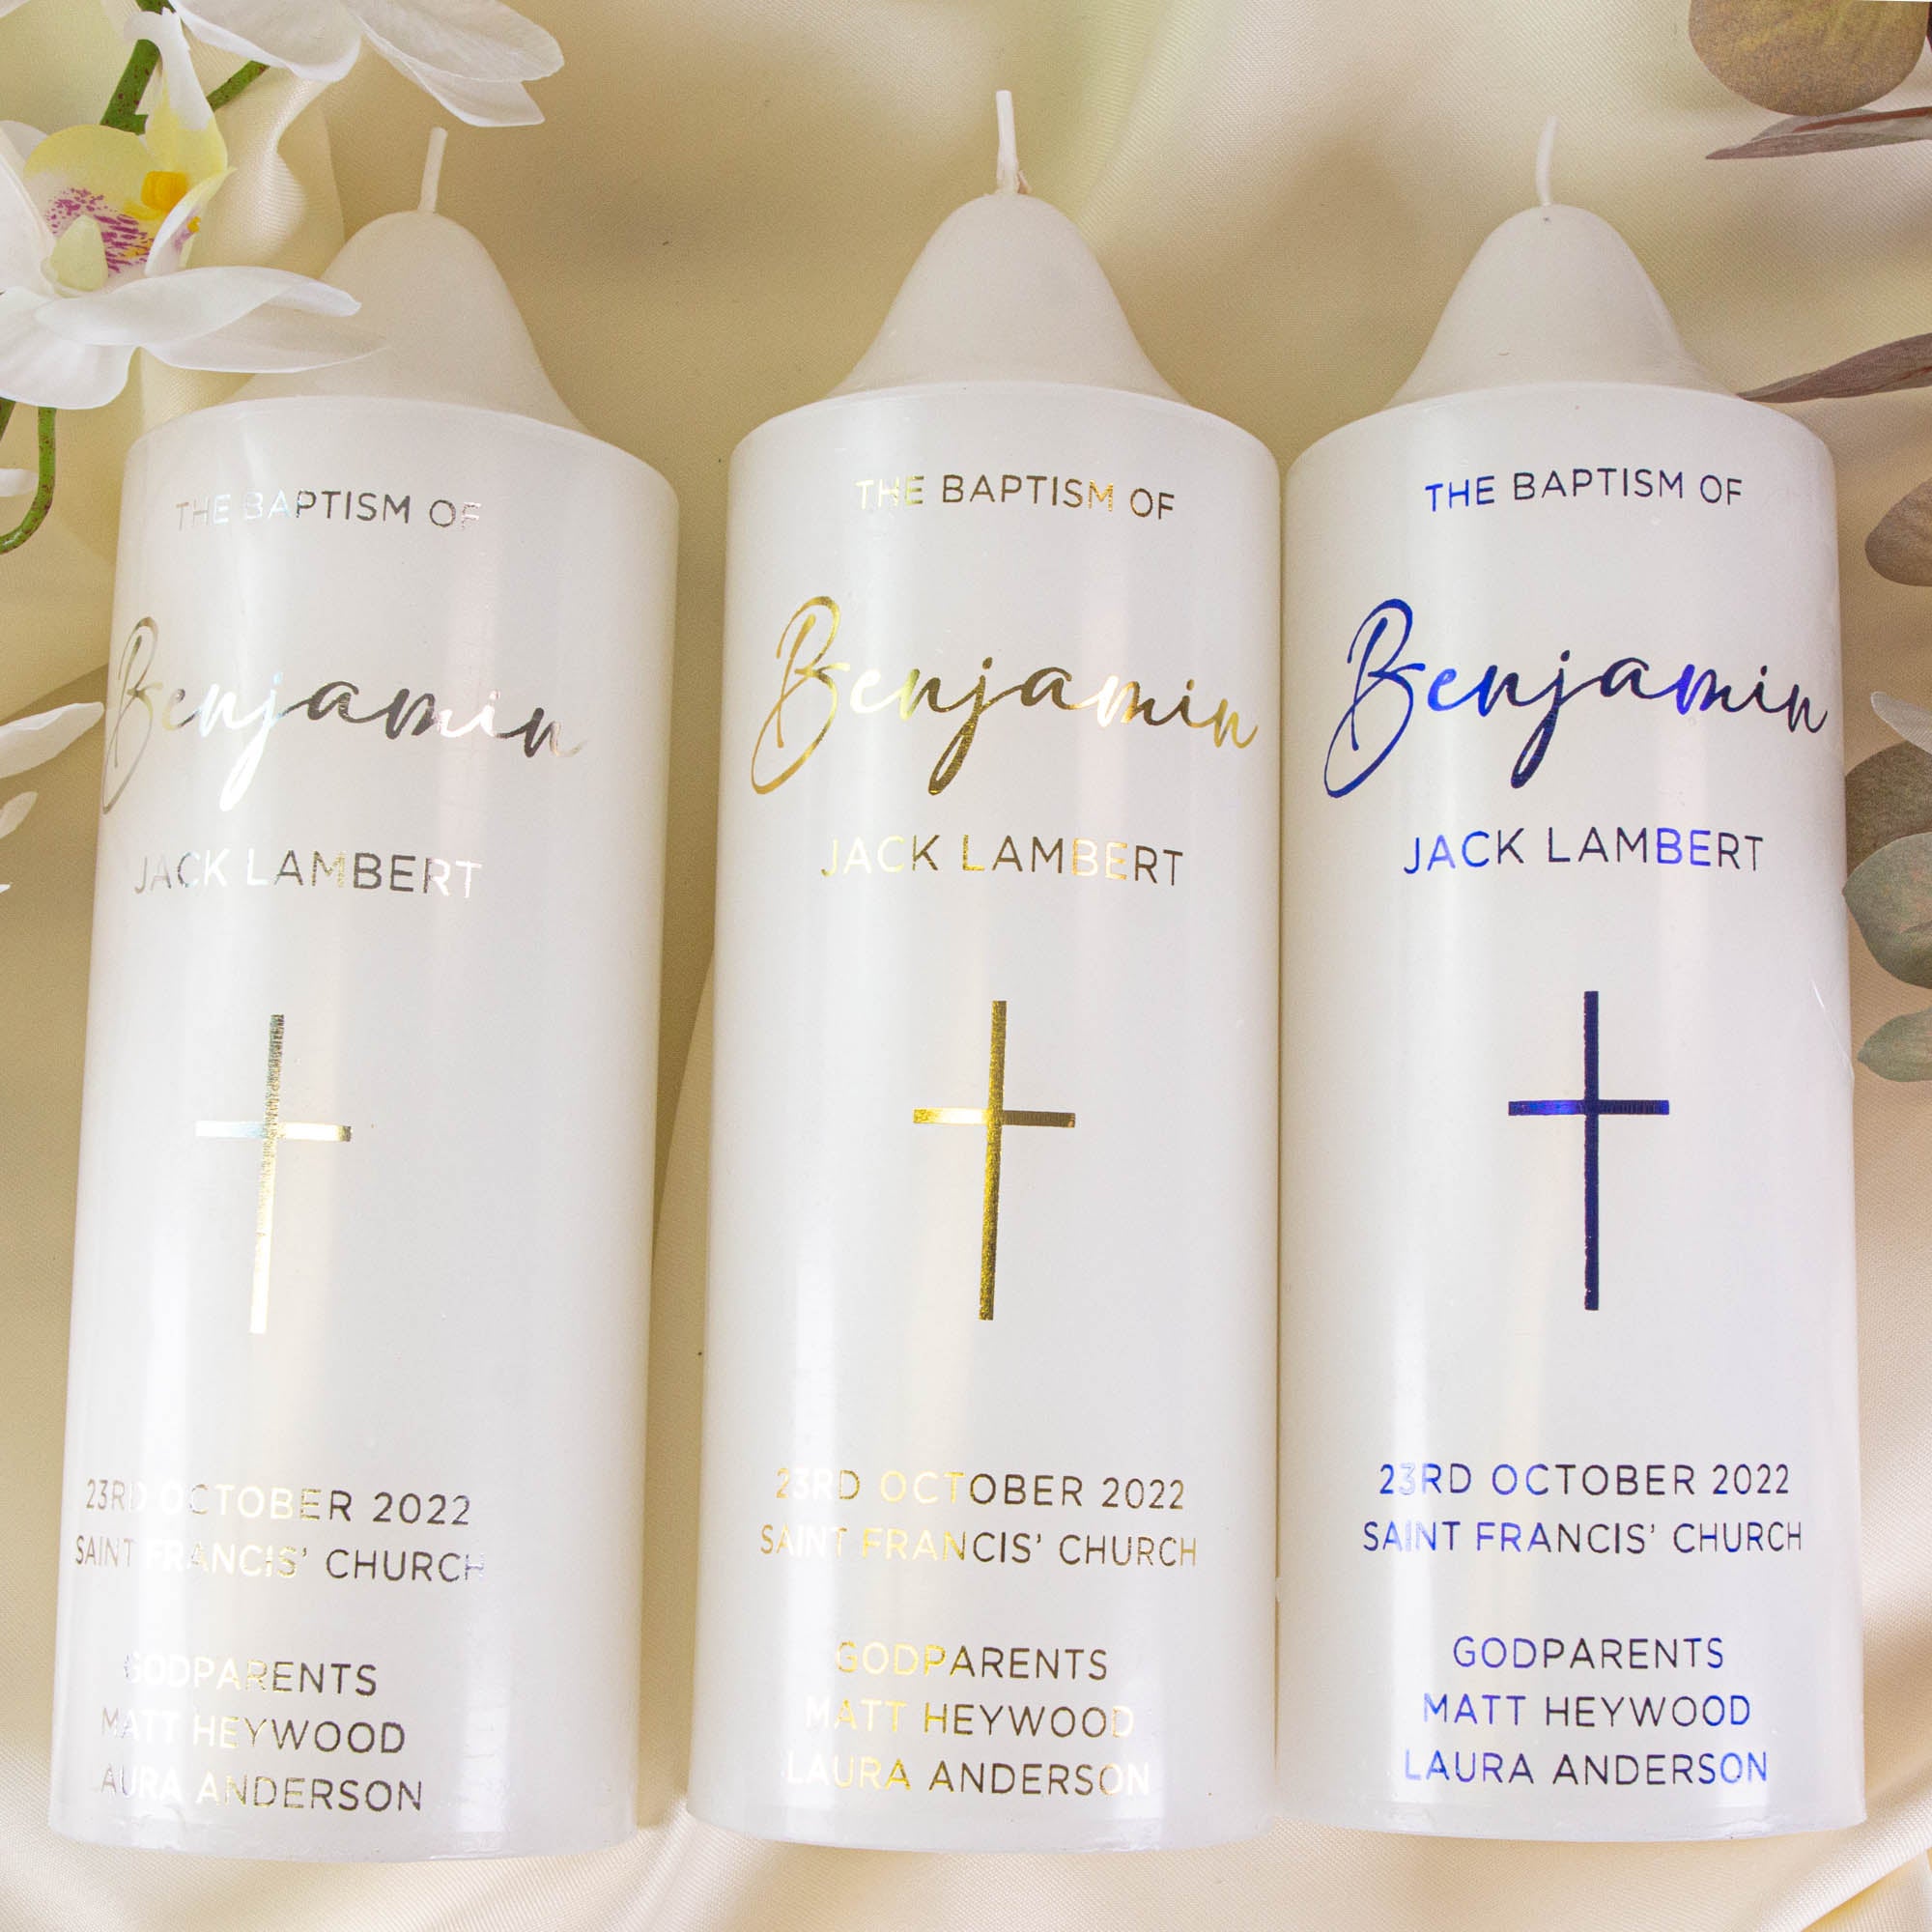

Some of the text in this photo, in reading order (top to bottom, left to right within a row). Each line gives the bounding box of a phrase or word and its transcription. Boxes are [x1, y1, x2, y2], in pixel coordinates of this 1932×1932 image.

[244, 490, 411, 524] BAPTISM
[428, 499, 482, 530] OF
[856, 474, 1175, 520] THE BAPTISM OF
[1425, 469, 1743, 512] THE BAPTISM OF
[101, 616, 588, 814] Benjamin
[751, 596, 1258, 796] Benjamin
[1323, 598, 1828, 798] Benjamin
[821, 835, 1183, 886] JACK LAMBERT
[1404, 827, 1763, 874] JACK LAMBERT
[134, 848, 483, 898] JACK LAMBERT
[776, 1468, 1184, 1509] 23RD OCTOBER 2022
[1379, 1463, 1790, 1495] 23RD OCTOBER 2022
[160, 1484, 352, 1521] OCTOBER
[373, 1492, 470, 1526] 2022
[760, 1524, 848, 1557] SAINT
[1059, 1534, 1197, 1567] CHURCH
[1363, 1520, 1461, 1552] SAINT
[1673, 1522, 1802, 1553] CHURCH
[75, 1535, 134, 1568] SAINT
[326, 1549, 484, 1582] CHURCH
[835, 1640, 1107, 1680] GODPARENTS
[1453, 1636, 1724, 1669] GODPARENTS
[124, 1653, 377, 1697] GODPARENTS
[101, 1707, 406, 1754] MATT HEYWOOD
[806, 1695, 1134, 1738] MATT HEYWOOD
[1424, 1693, 1750, 1727] MATT HEYWOOD
[786, 1752, 1150, 1796] LAURA ANDERSON
[1405, 1749, 1768, 1785] LAURA ANDERSON
[196, 1771, 423, 1812] ANDERSON
